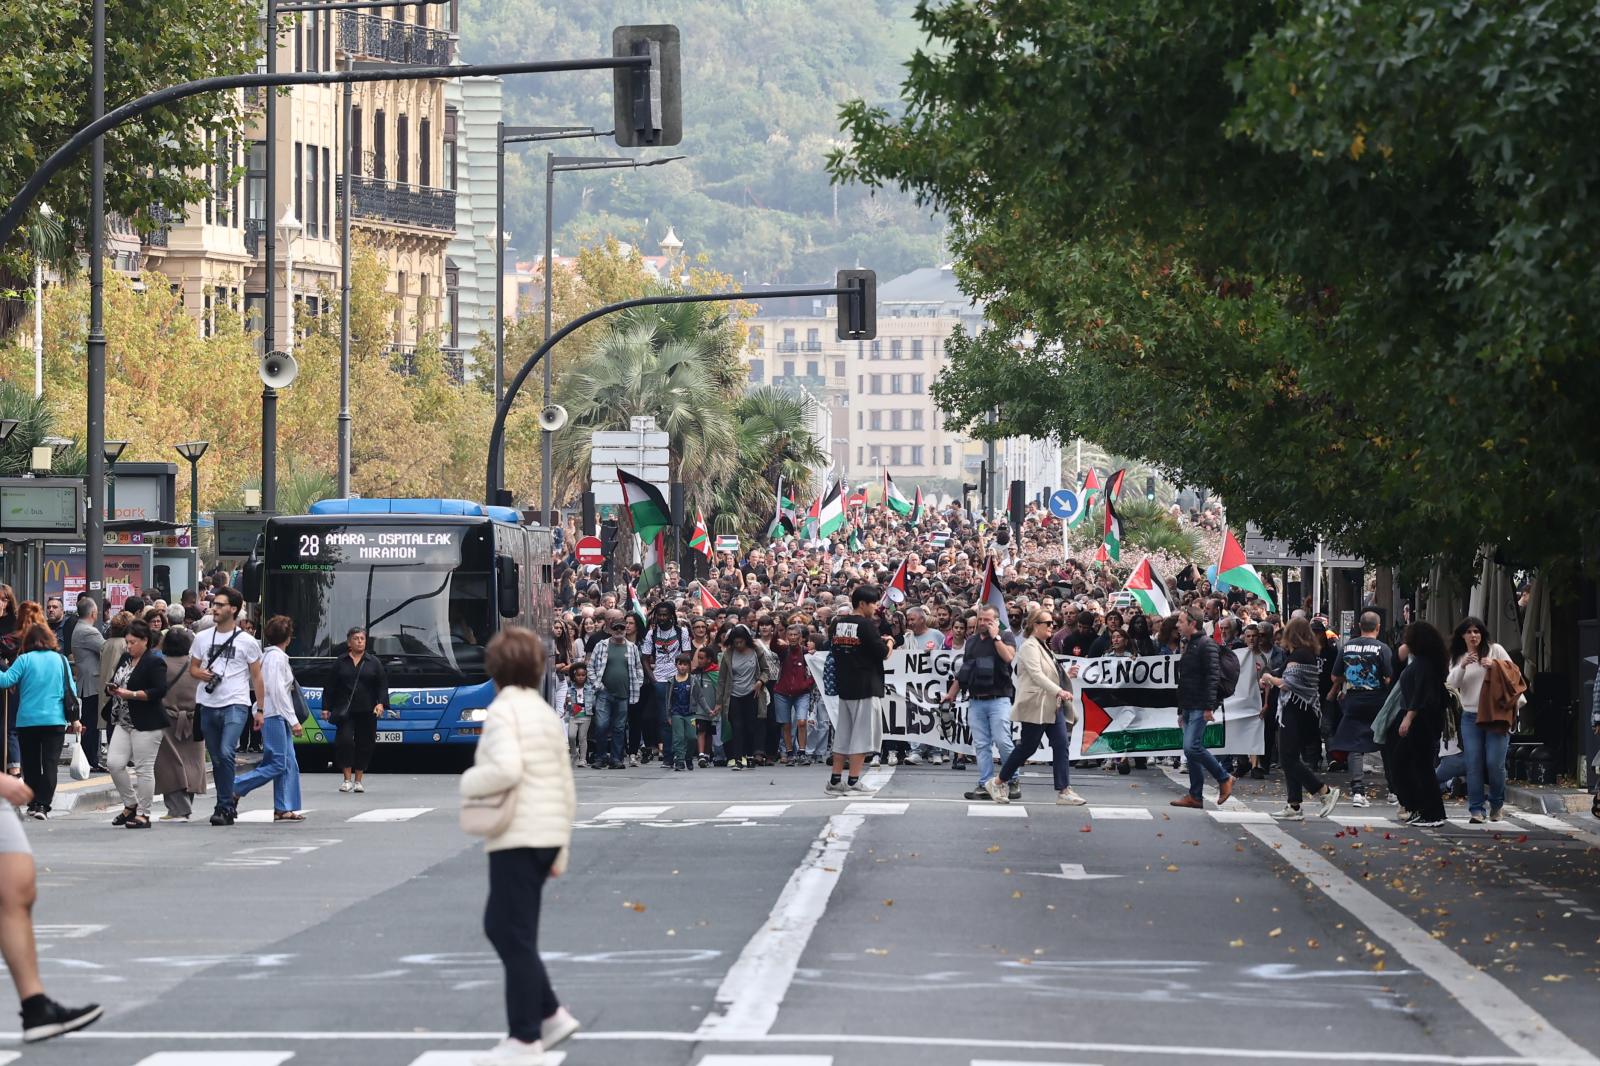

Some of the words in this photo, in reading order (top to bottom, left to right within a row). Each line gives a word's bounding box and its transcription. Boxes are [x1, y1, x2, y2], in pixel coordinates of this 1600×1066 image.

[132, 534, 141, 542] 21
[179, 537, 188, 545] 21
[325, 533, 365, 545] AMARA
[378, 533, 452, 545] OSPITALEAK
[299, 534, 320, 556] 28
[359, 547, 417, 559] MIRAMON
[304, 691, 322, 700] 499
[384, 733, 401, 742] KGB
